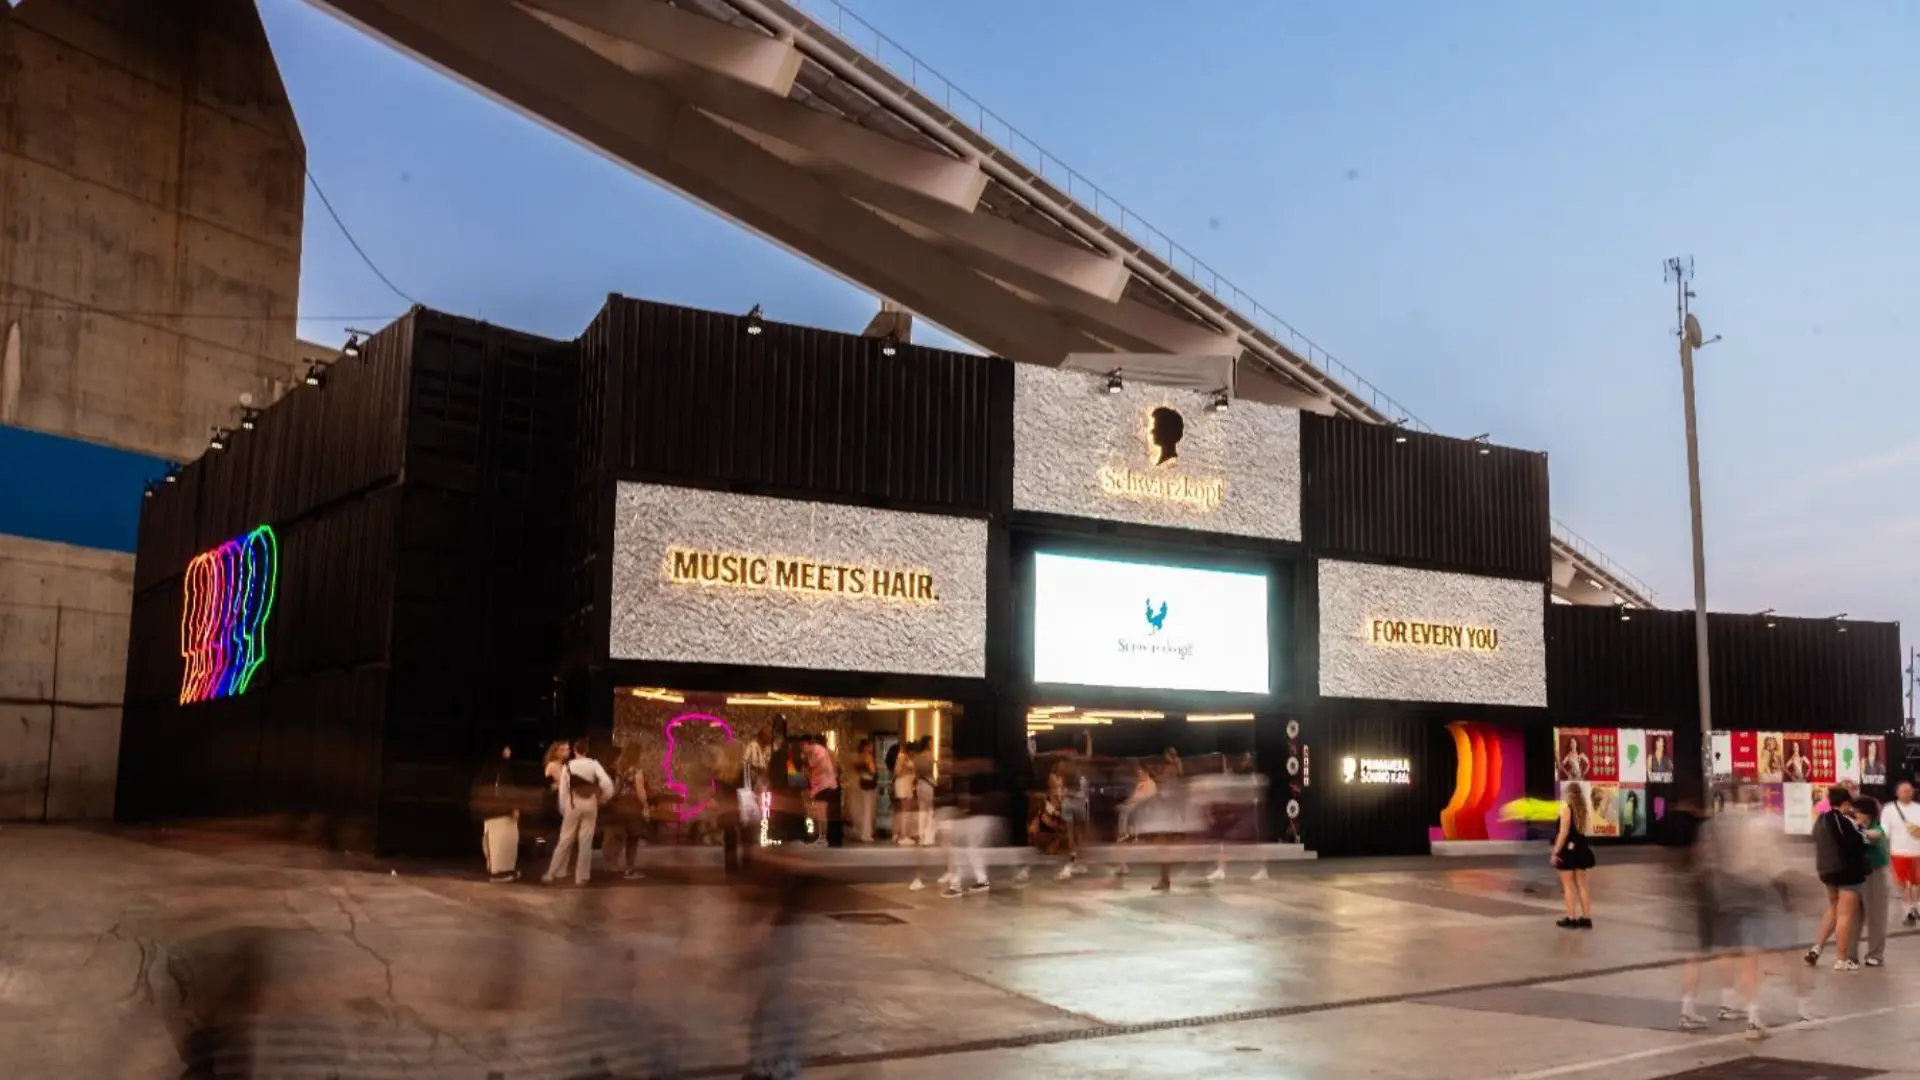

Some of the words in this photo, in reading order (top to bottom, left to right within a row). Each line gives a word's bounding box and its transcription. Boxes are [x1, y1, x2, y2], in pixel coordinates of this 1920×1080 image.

[1102, 468, 1223, 508] Schwarzkopf
[673, 551, 767, 585] MUSIC
[775, 560, 865, 594] MEETS
[872, 569, 940, 600] HAIR.
[1373, 620, 1407, 643] FOR
[1411, 622, 1462, 648] EVERY
[1466, 627, 1498, 650] YOU
